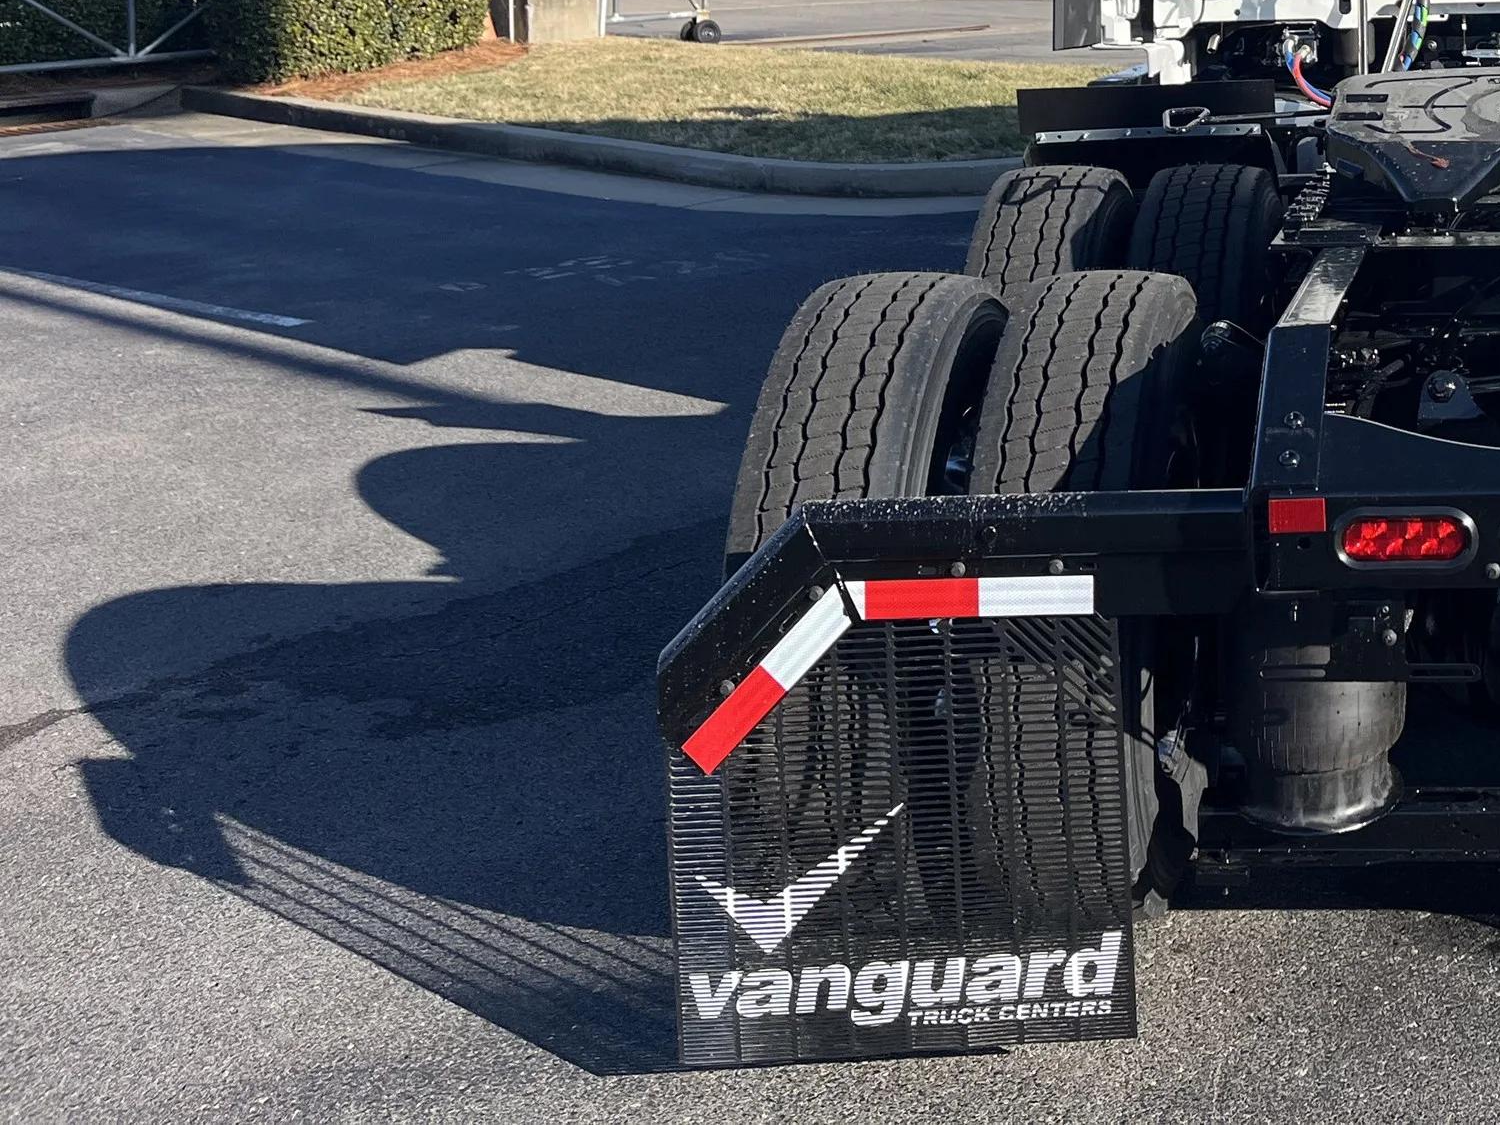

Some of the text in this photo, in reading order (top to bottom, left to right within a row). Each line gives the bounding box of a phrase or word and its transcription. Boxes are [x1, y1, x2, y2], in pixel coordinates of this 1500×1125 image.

[689, 931, 1122, 1026] vanguard
[907, 1000, 1112, 1027] TRUCK CENTERS
